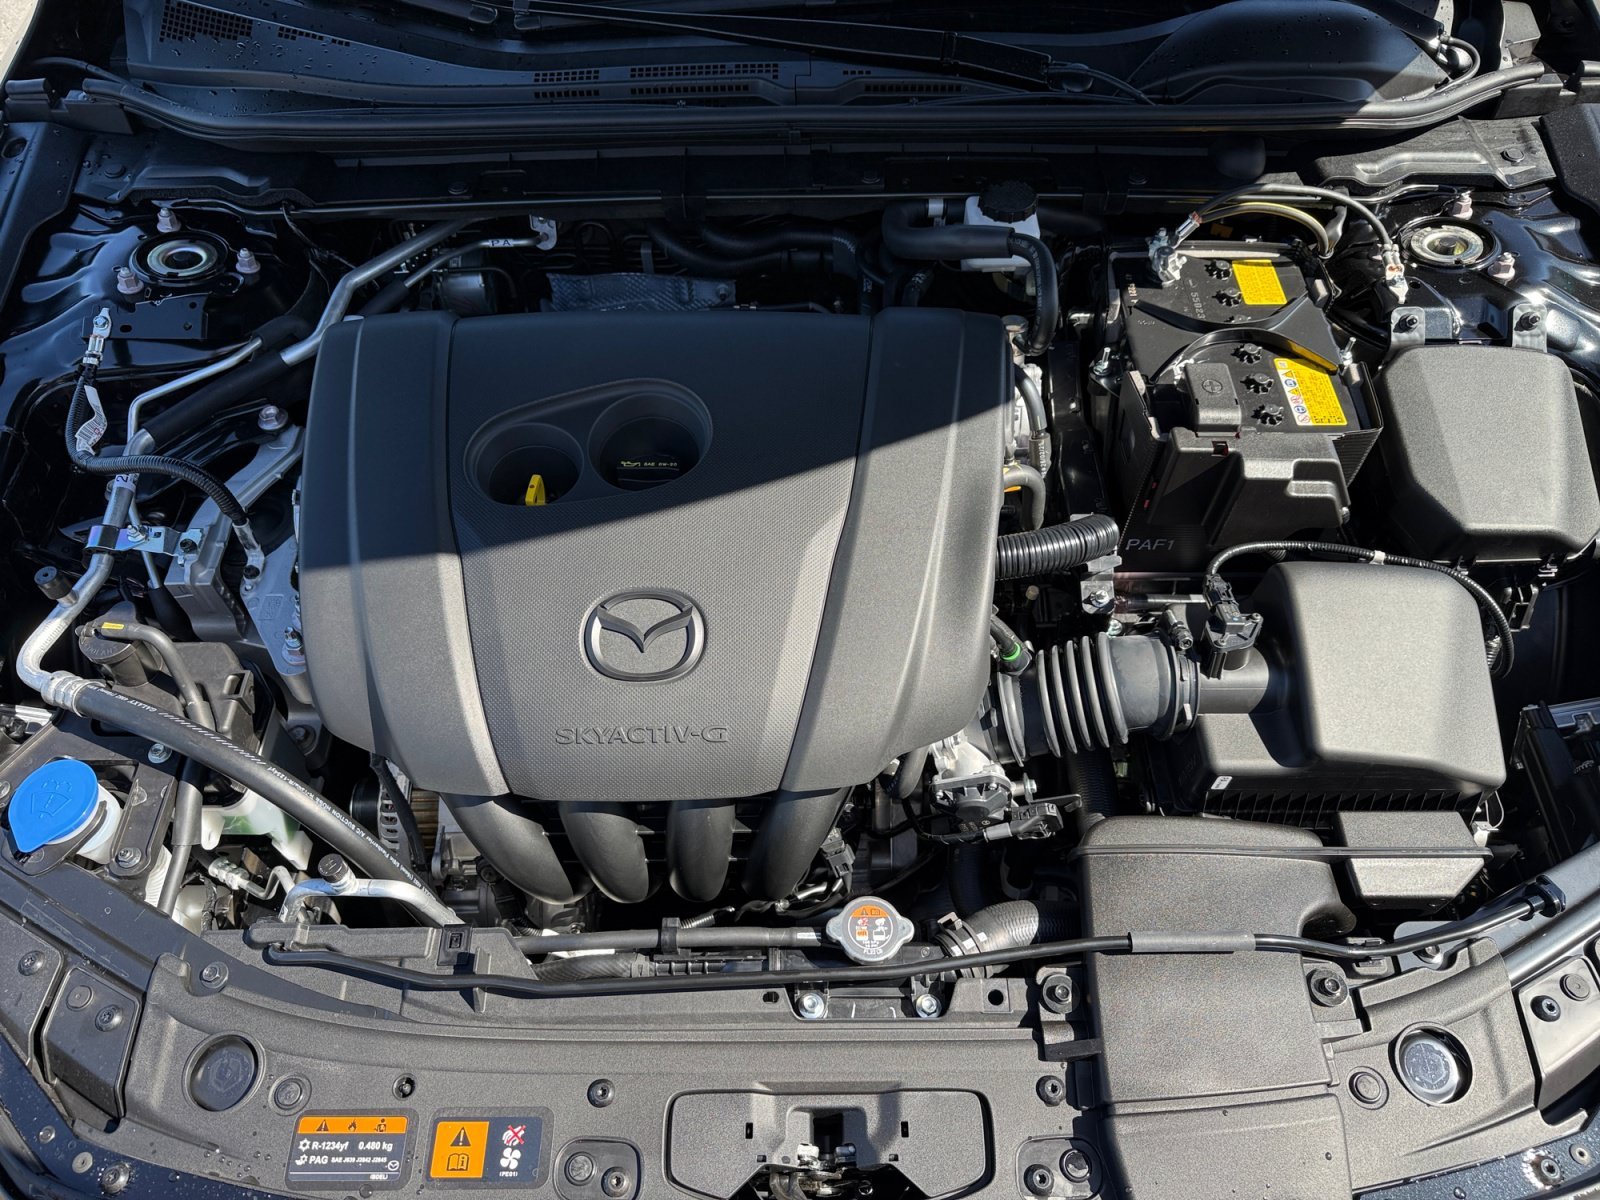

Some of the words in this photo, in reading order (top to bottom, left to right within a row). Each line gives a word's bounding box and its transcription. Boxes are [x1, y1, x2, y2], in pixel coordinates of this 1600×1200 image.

[1125, 538, 1175, 551] PAF1
[555, 724, 729, 745] SKYACTIV-G
[331, 809, 356, 831] SUCTION
[311, 1141, 349, 1152] R-1234yf
[358, 1141, 381, 1150] 0.480
[382, 1141, 393, 1152] kg
[308, 1155, 329, 1165] PAG
